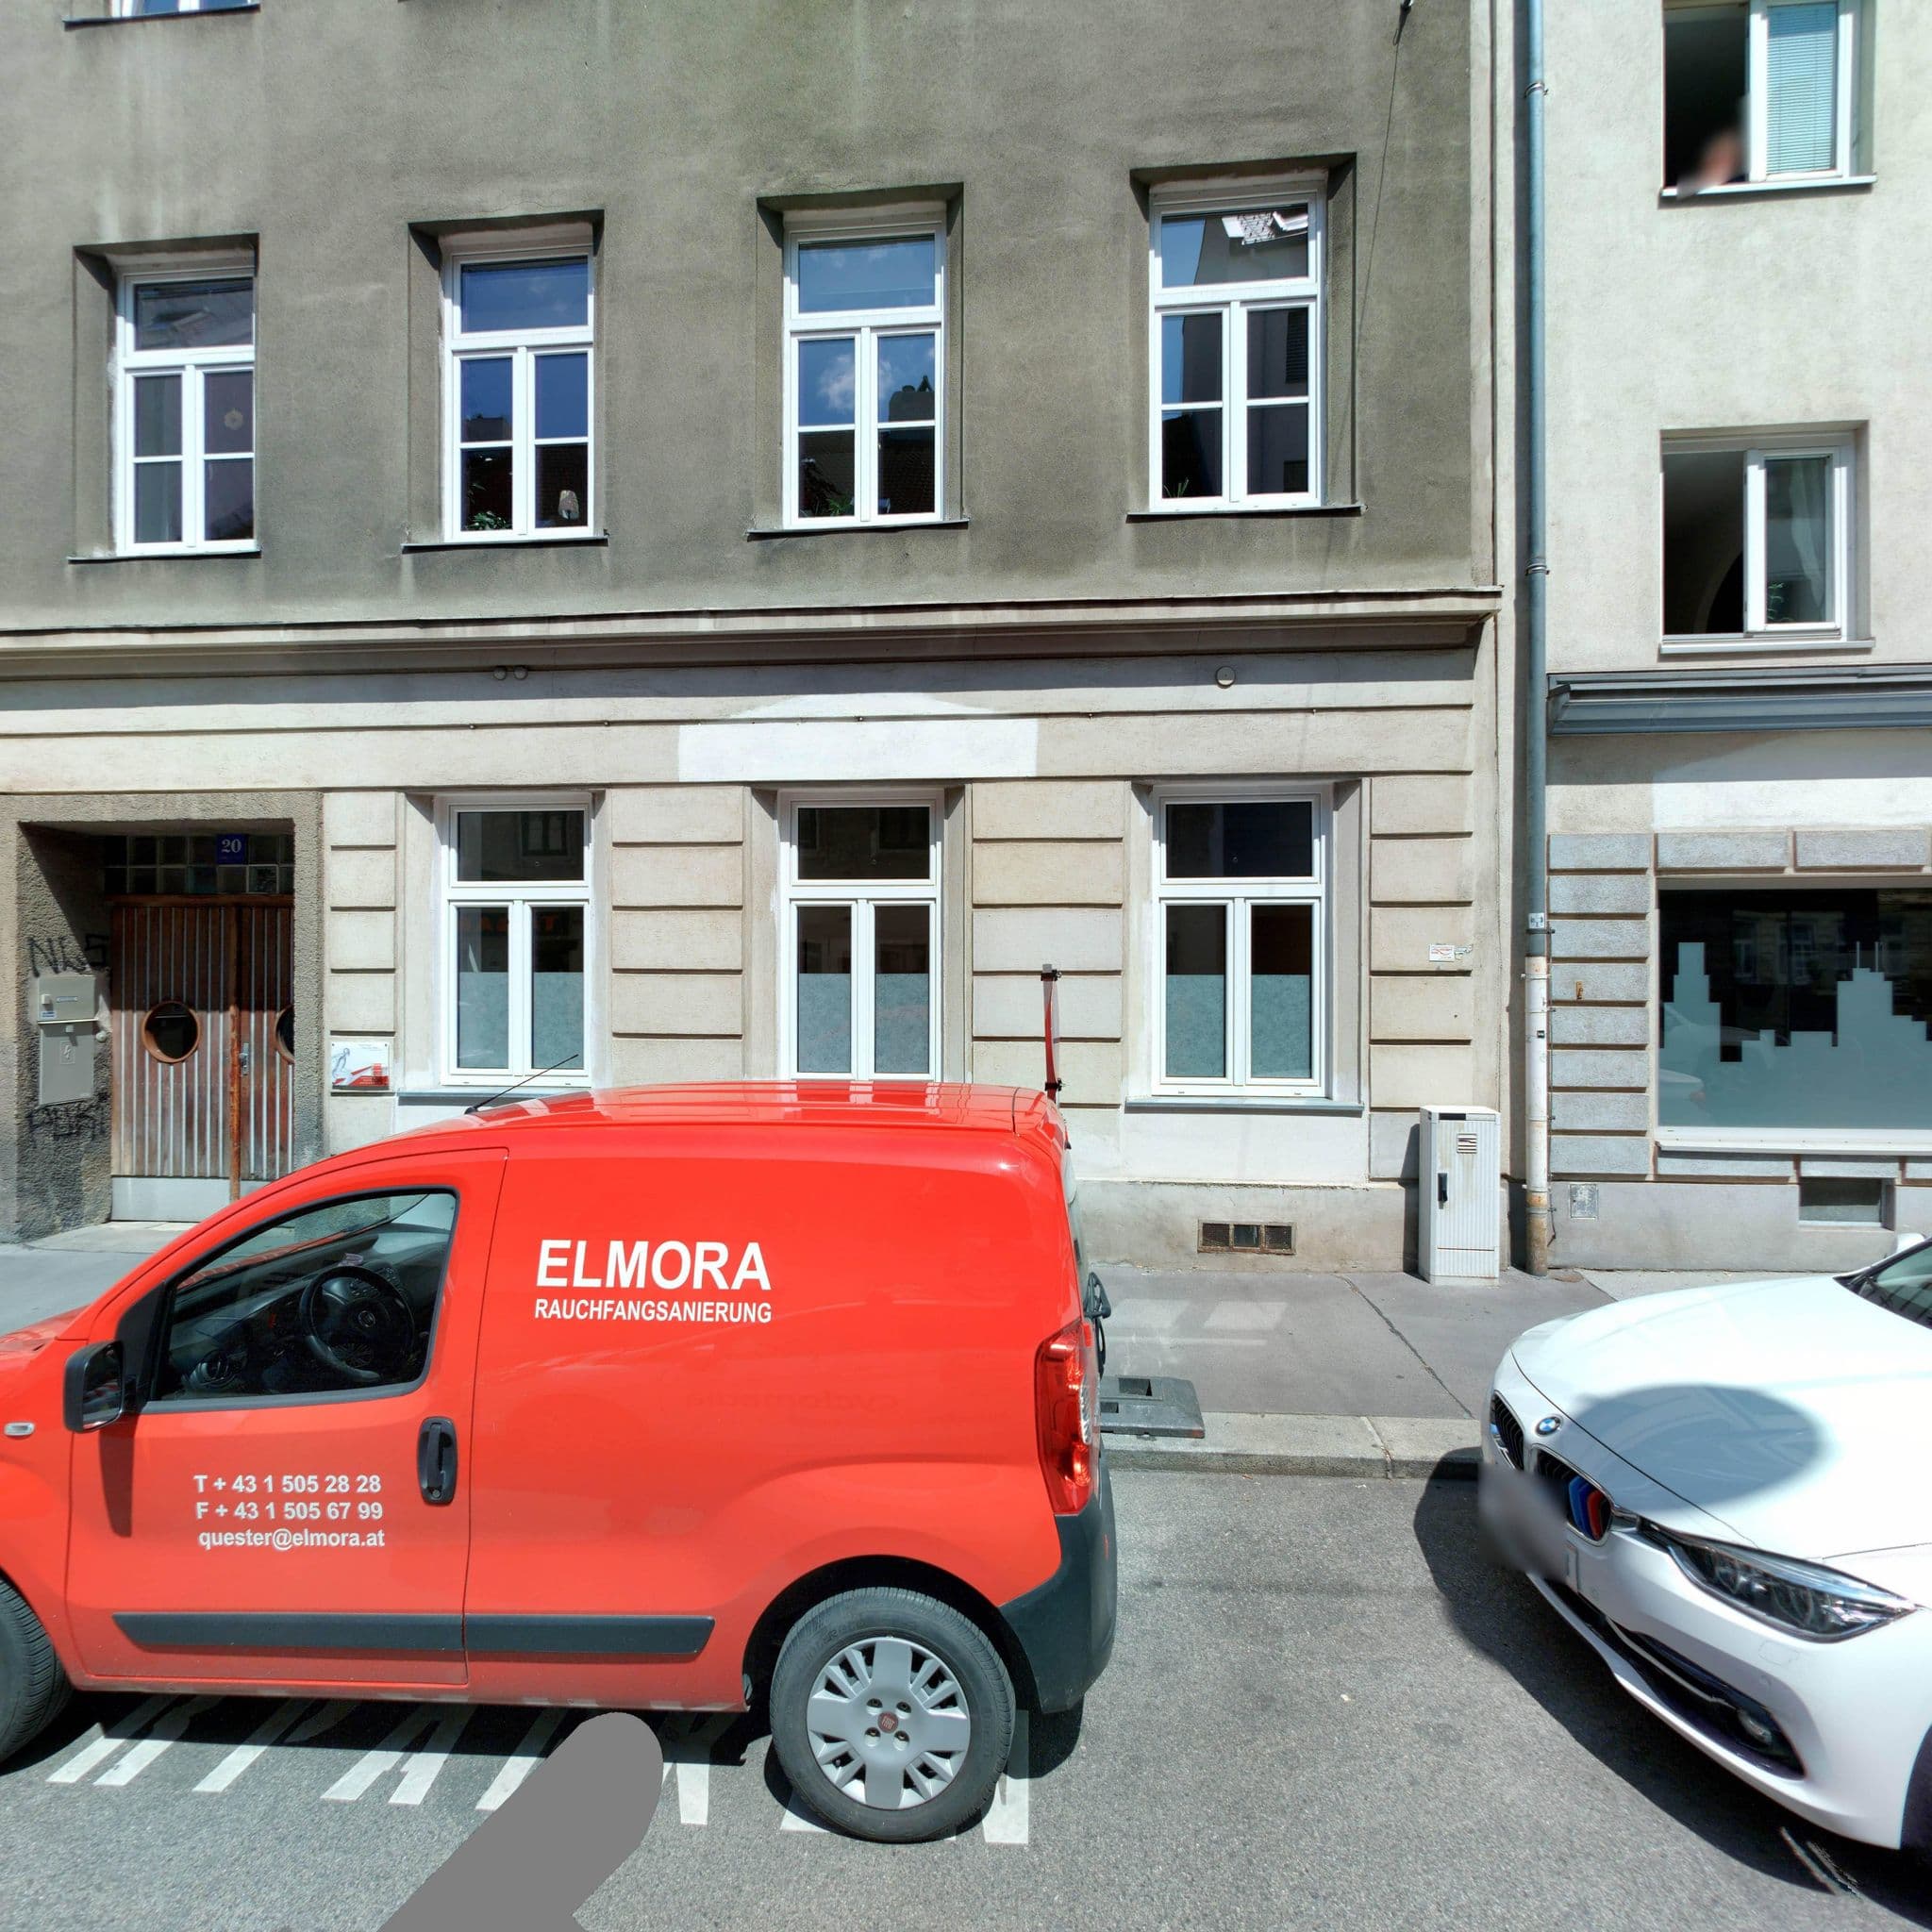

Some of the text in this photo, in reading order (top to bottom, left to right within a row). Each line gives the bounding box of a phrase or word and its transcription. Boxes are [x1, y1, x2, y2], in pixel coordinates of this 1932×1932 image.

[221, 839, 242, 854] 20
[536, 1239, 772, 1291] ELMORA
[535, 1298, 773, 1324] RAUCHFANGSANIERUNG
[193, 1474, 208, 1493] T
[231, 1474, 258, 1493] 43
[263, 1474, 274, 1493] 1
[281, 1474, 320, 1493] 505
[325, 1474, 350, 1493] 28
[356, 1474, 382, 1493] 28
[195, 1501, 209, 1520] F
[233, 1501, 259, 1520] 43
[265, 1501, 275, 1520] 1
[283, 1501, 322, 1520] 505
[326, 1501, 352, 1520] 67
[357, 1501, 384, 1520] 99
[198, 1527, 386, 1552] quester@elmora.at
